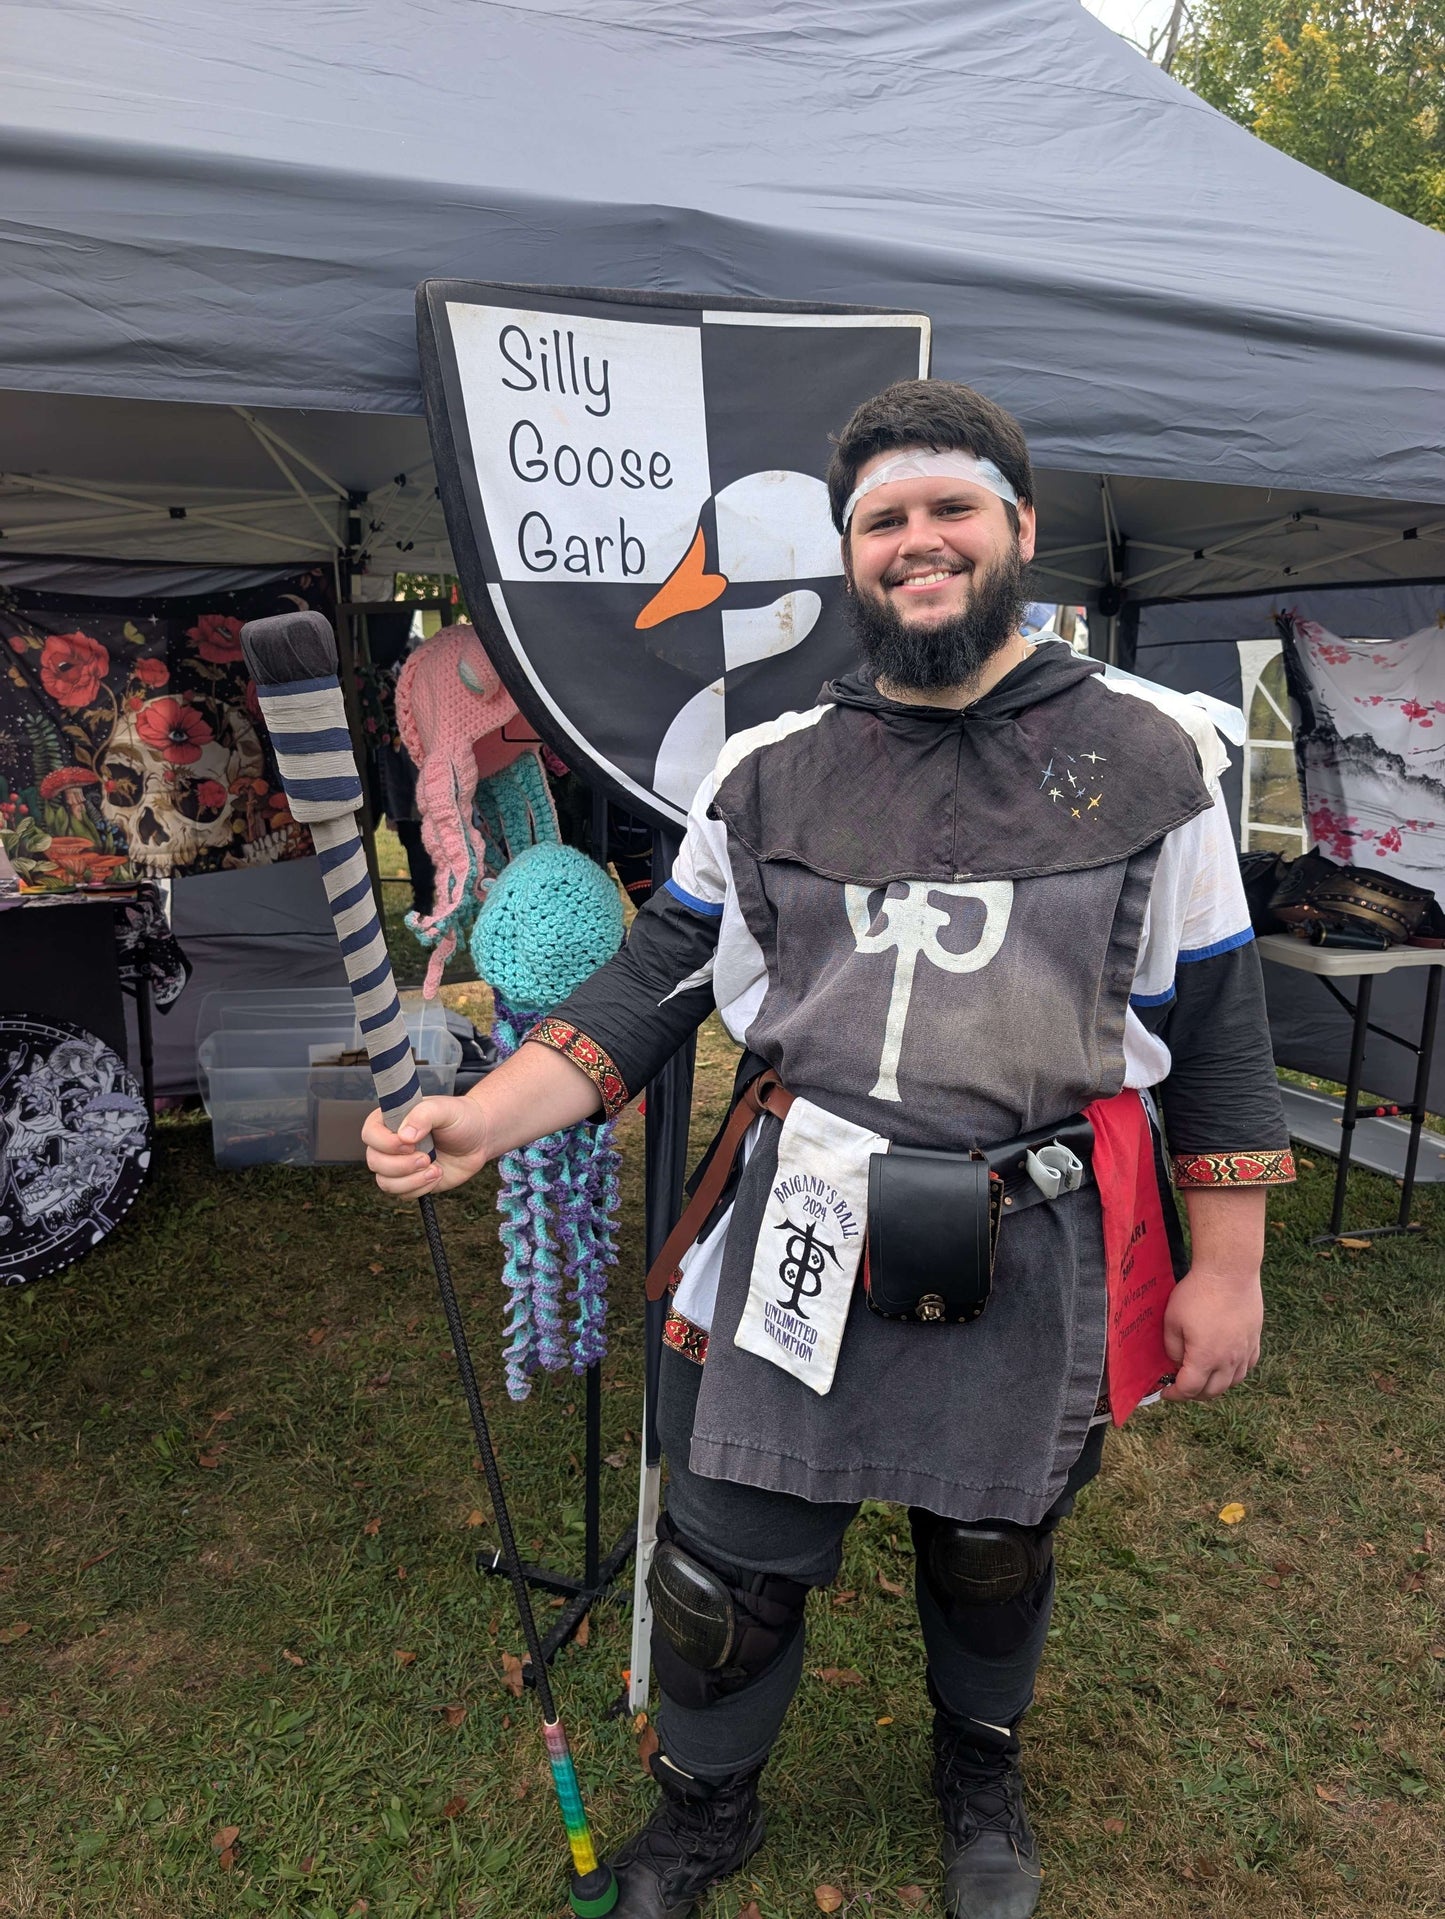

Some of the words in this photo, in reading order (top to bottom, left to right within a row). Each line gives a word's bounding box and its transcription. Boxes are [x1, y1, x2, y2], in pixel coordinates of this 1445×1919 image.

[499, 324, 611, 417] Silly
[509, 419, 673, 490] Goose
[518, 510, 646, 577] Garb
[773, 1174, 838, 1205] BRIGAND'S
[832, 1199, 860, 1240] BALL
[802, 1194, 827, 1223] 2024
[764, 1301, 818, 1345] UNLIMITED
[764, 1317, 814, 1363] CHAMPION
